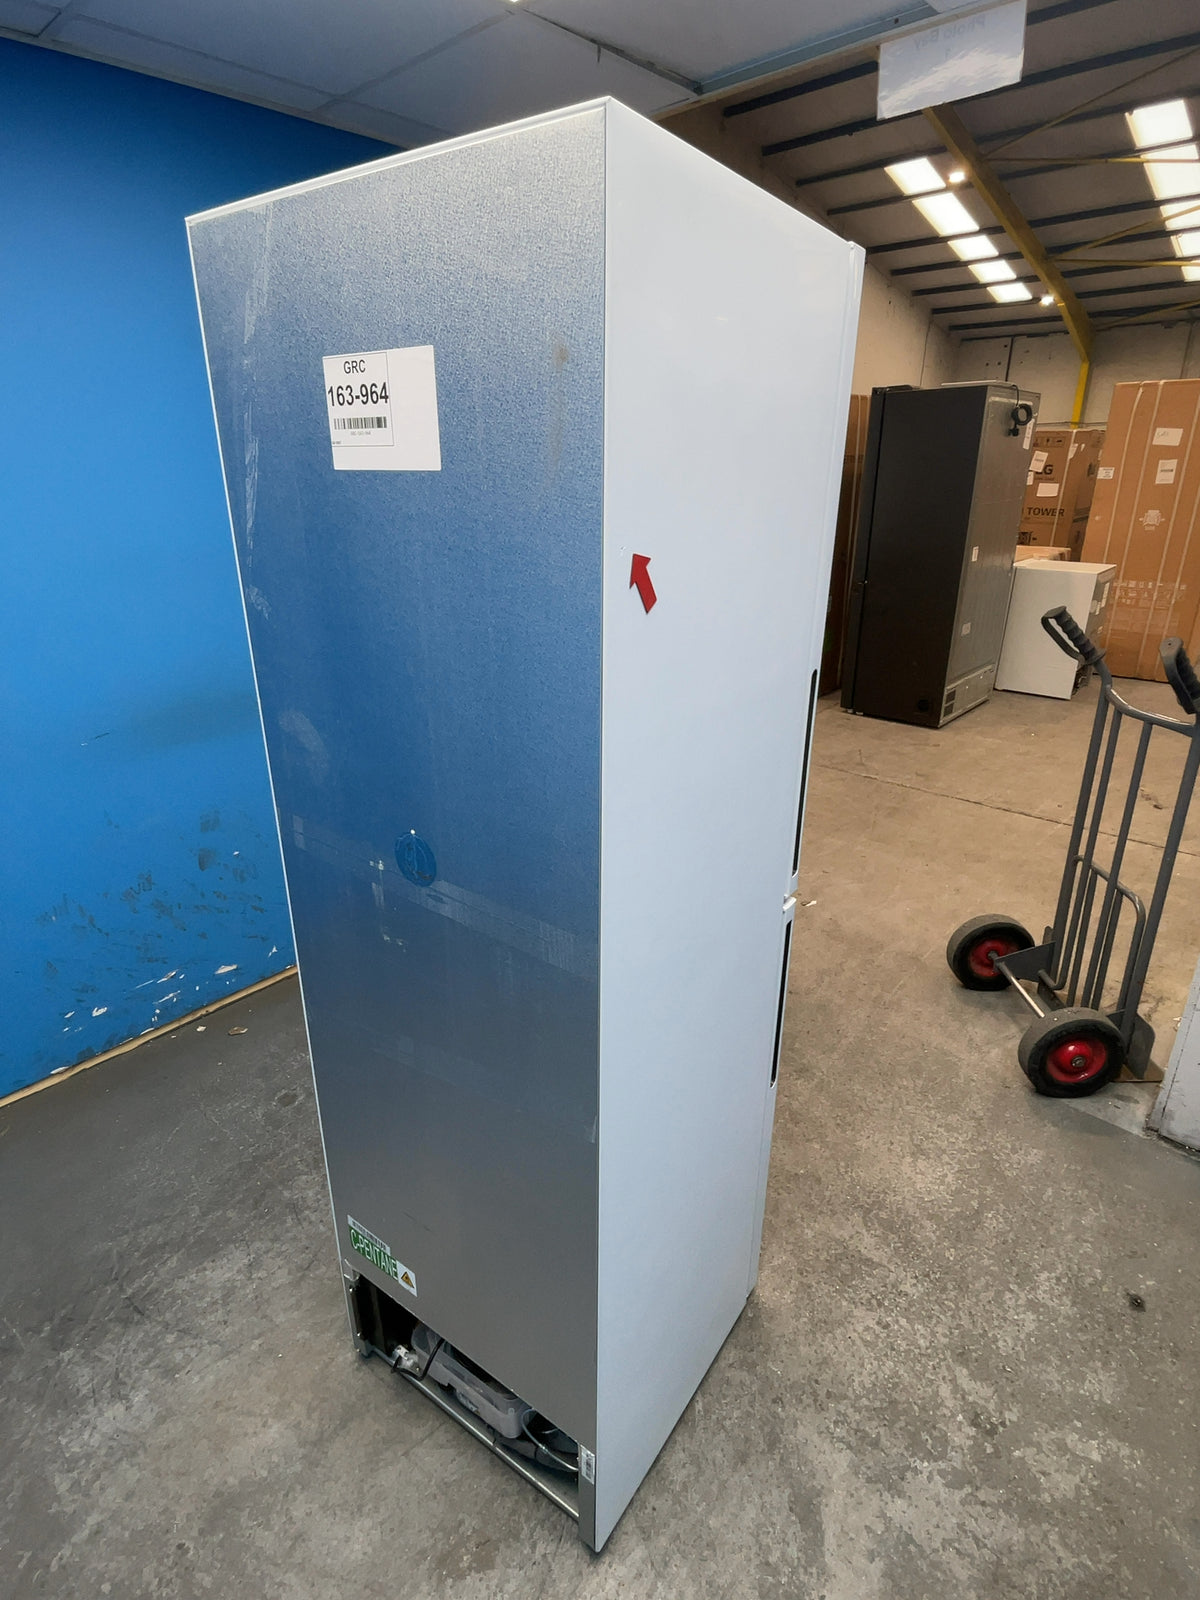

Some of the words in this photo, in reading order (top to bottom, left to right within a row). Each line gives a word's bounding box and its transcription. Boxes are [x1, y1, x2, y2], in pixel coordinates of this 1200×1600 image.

[343, 359, 366, 374] GRC
[327, 381, 389, 407] 163-964
[1026, 506, 1065, 518] TOWER
[350, 1229, 399, 1281] C-PENTANE
